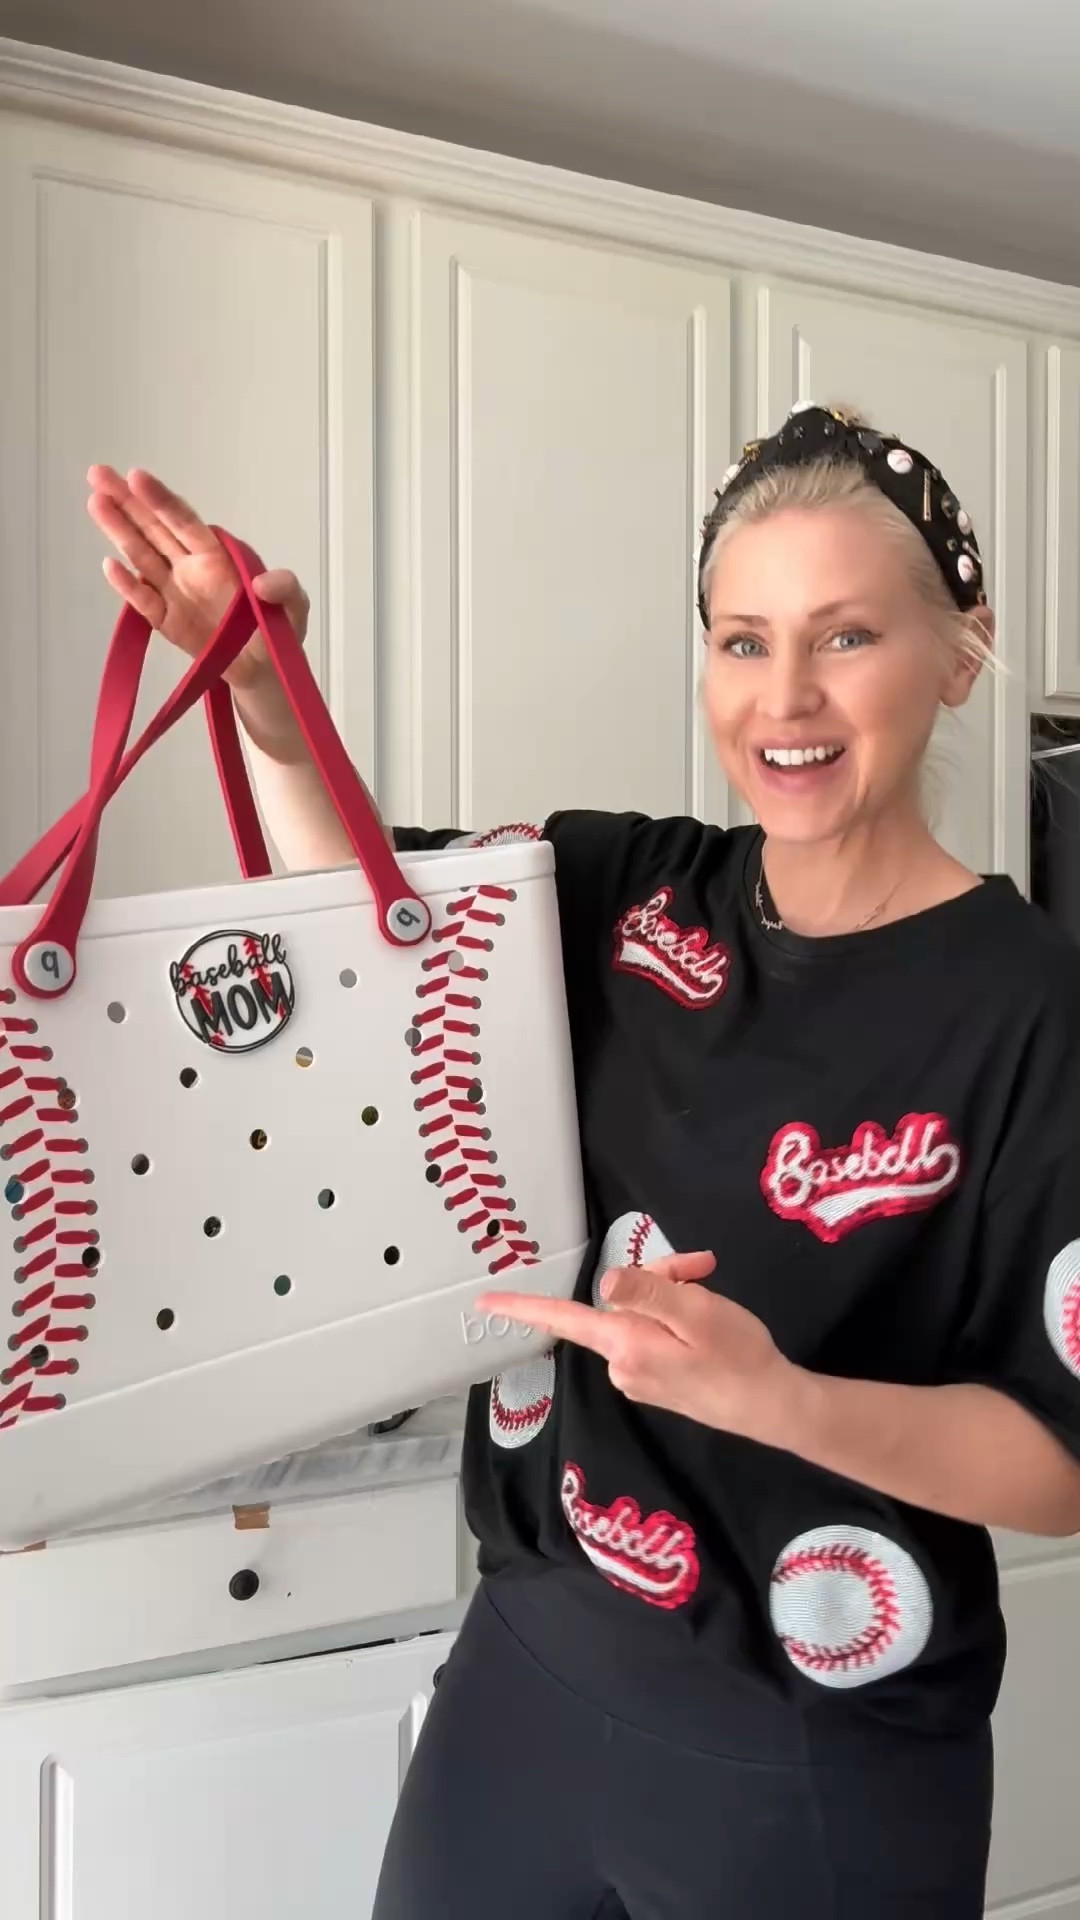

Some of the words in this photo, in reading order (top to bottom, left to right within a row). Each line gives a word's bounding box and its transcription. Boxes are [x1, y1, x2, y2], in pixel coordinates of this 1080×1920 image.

[169, 933, 287, 997] baseball
[190, 971, 293, 1043] MOM
[768, 1121, 956, 1208] Baseball
